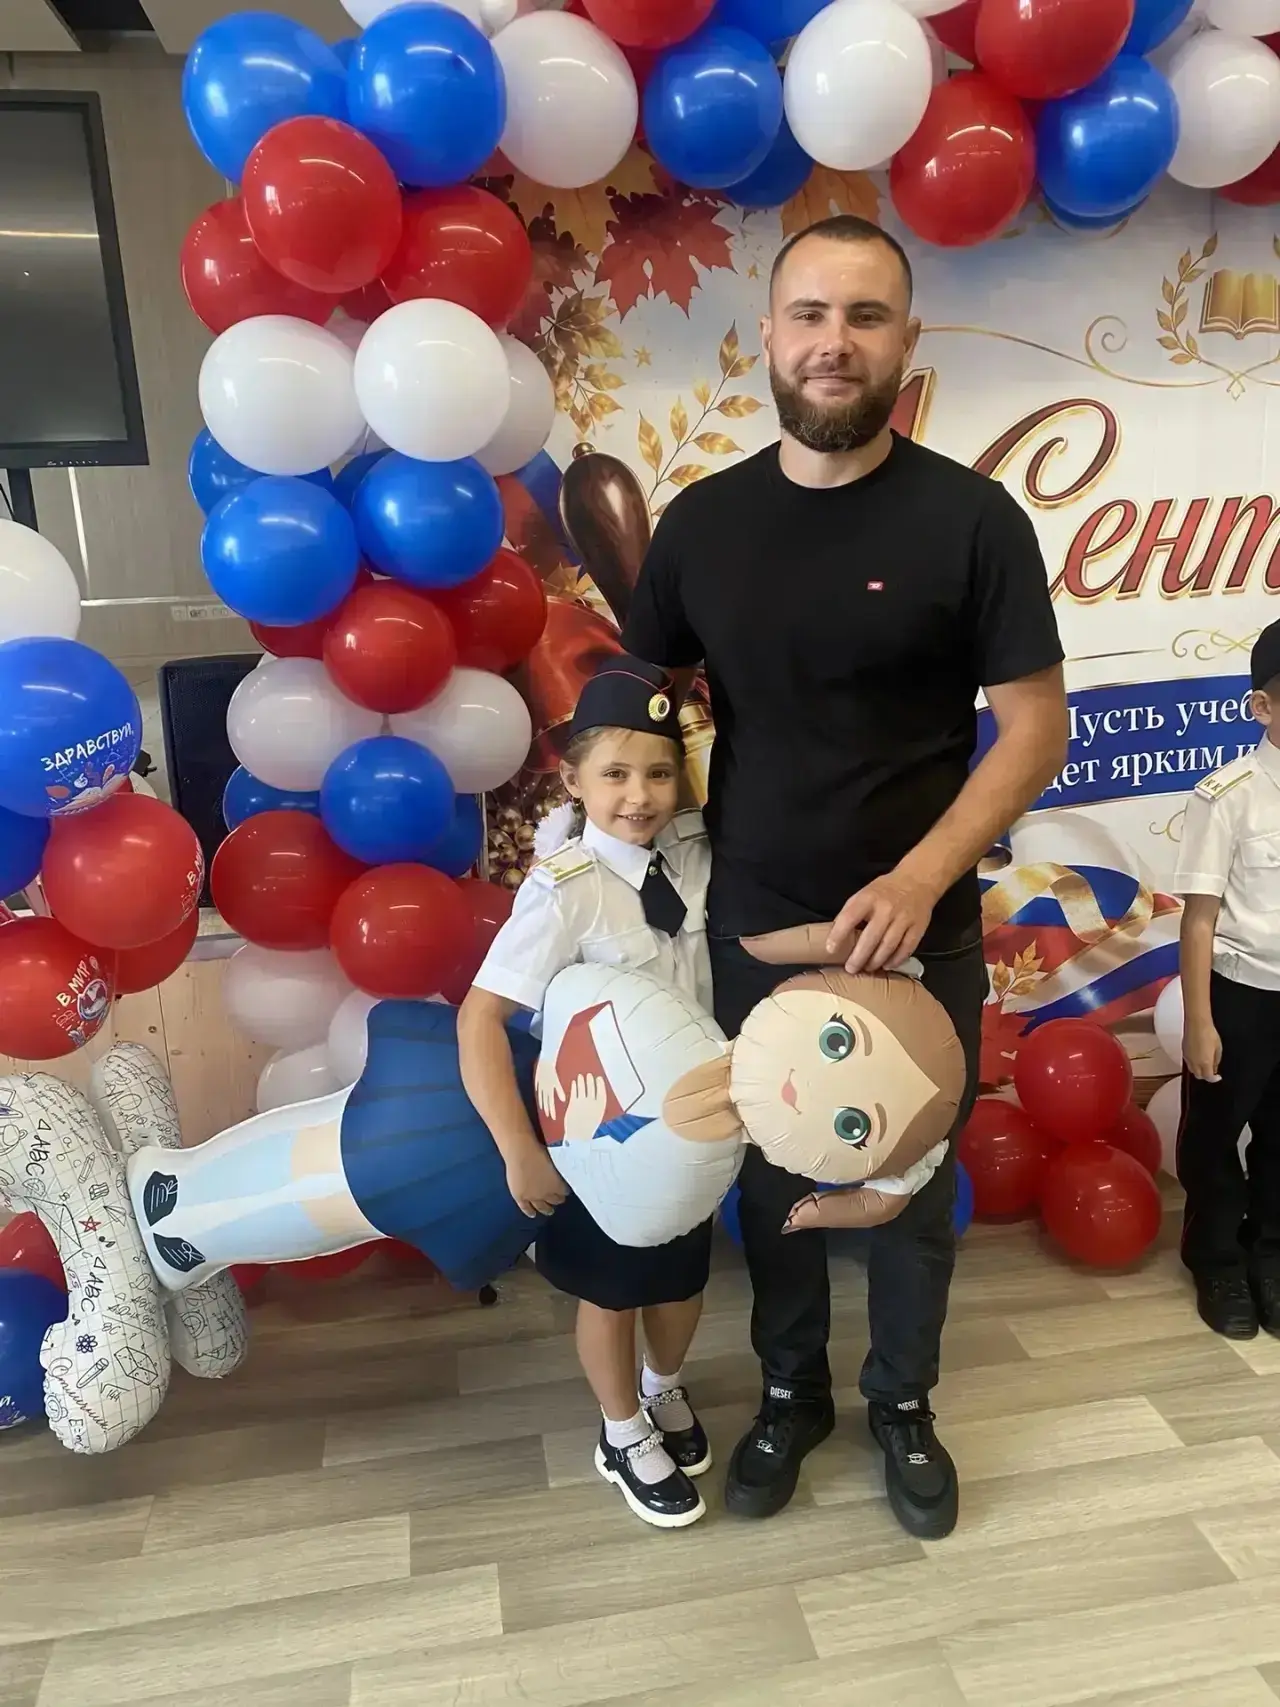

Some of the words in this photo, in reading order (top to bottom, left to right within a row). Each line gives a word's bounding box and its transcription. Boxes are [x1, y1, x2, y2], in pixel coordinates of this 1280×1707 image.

[1111, 745, 1224, 786] ярким
[56, 992, 71, 1007] В
[68, 960, 90, 994] МИР
[770, 1386, 793, 1399] DIESEL
